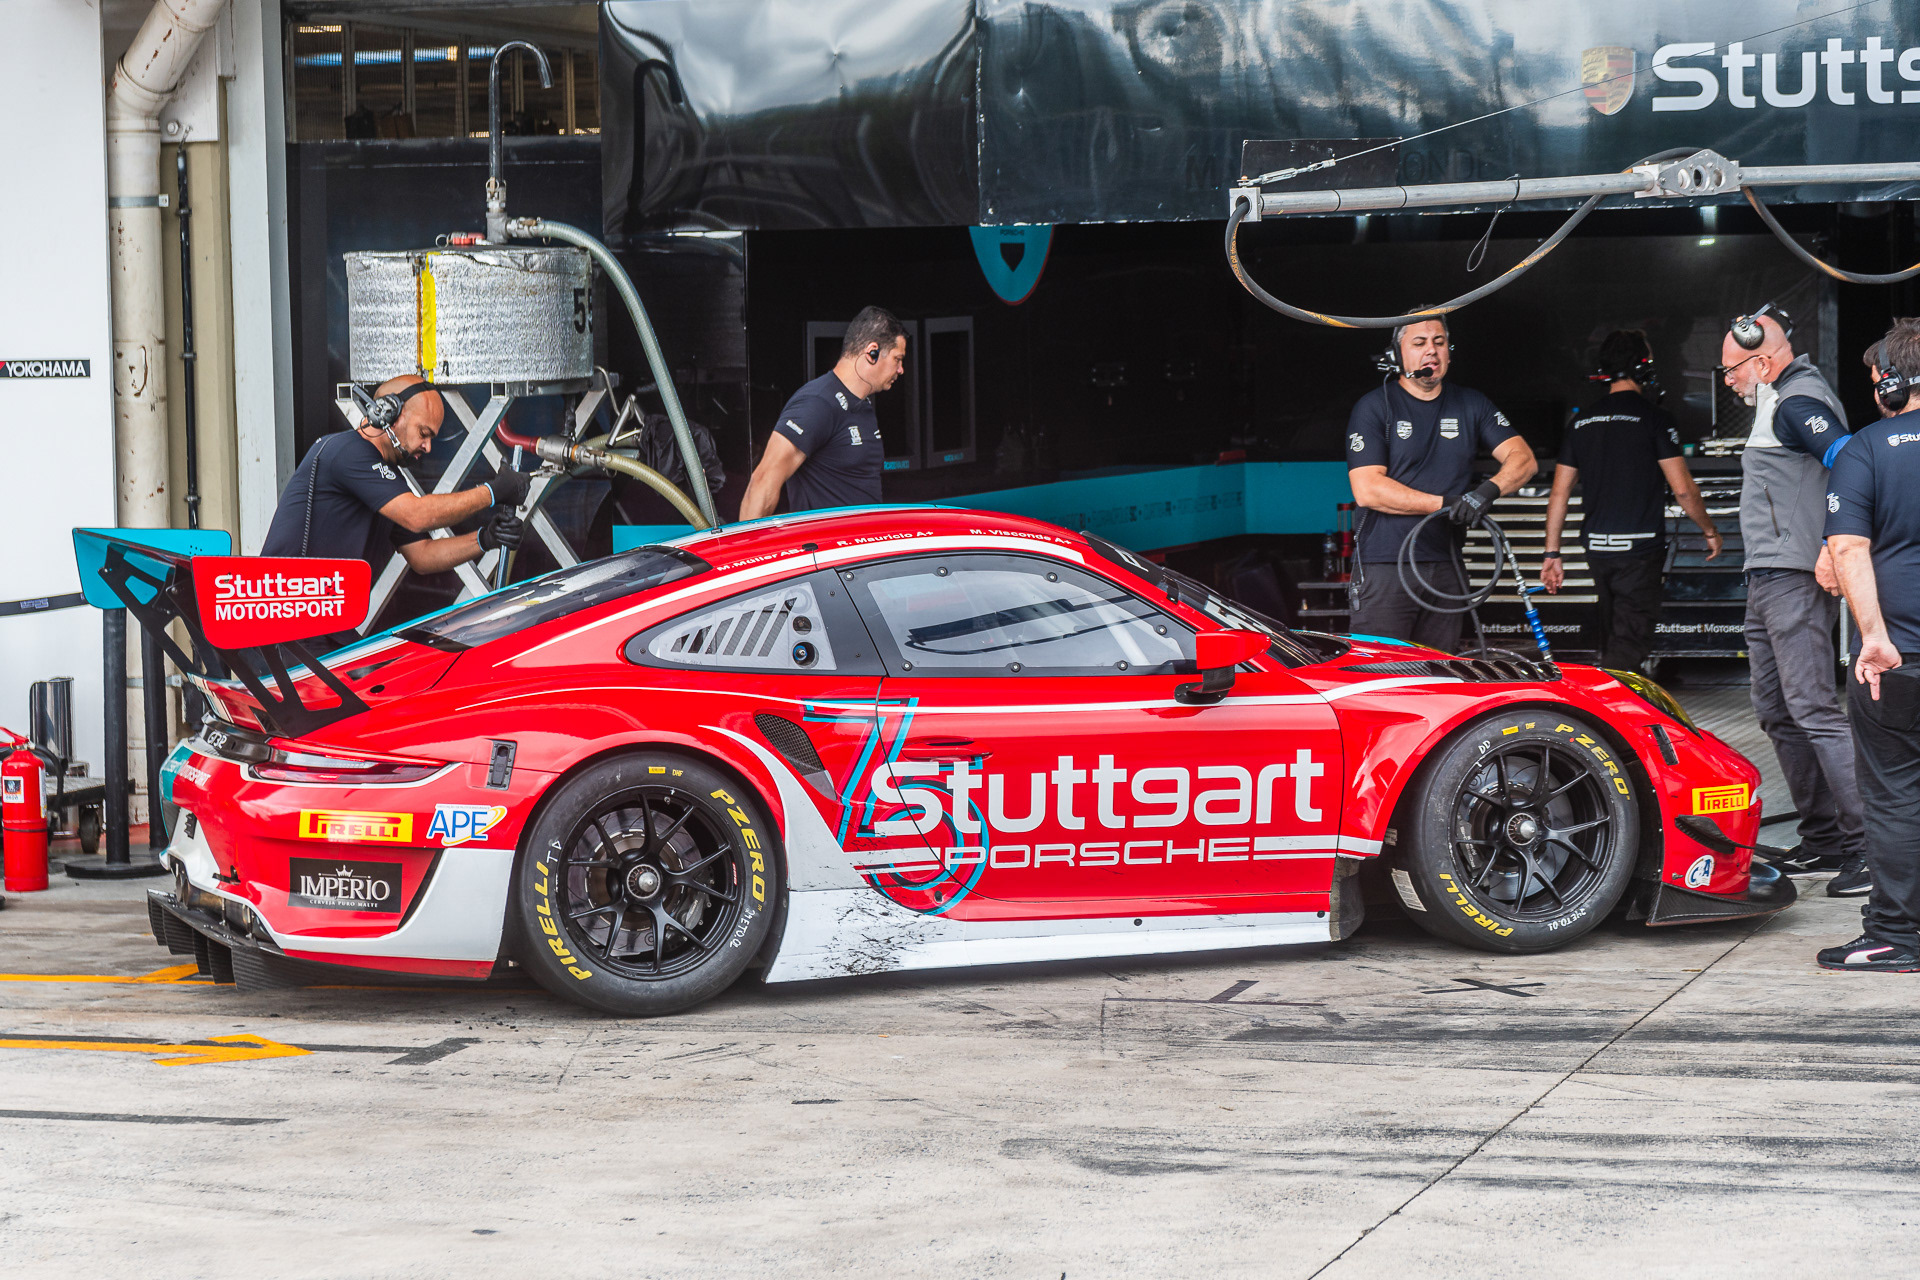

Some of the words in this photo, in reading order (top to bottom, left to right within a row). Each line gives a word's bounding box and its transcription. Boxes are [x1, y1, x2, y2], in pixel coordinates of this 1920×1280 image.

[5, 361, 87, 377] YOKOHAMA
[987, 529, 1052, 541] Visconde
[1054, 537, 1072, 545] A+
[214, 571, 345, 599] Stuttgart
[215, 600, 345, 621] MOTORSPORT
[1475, 618, 1522, 633] tuttgart
[1523, 618, 1581, 633] MORSPORT
[871, 749, 1324, 836] Stuttgart
[1700, 787, 1744, 811] PIRELLI
[309, 813, 402, 838] PIRELLI
[428, 810, 488, 839] APE
[945, 838, 1253, 871] PORSCHE
[1690, 859, 1711, 883] CA
[1438, 873, 1514, 938] PIRELLI
[534, 861, 593, 981] PIRELLI
